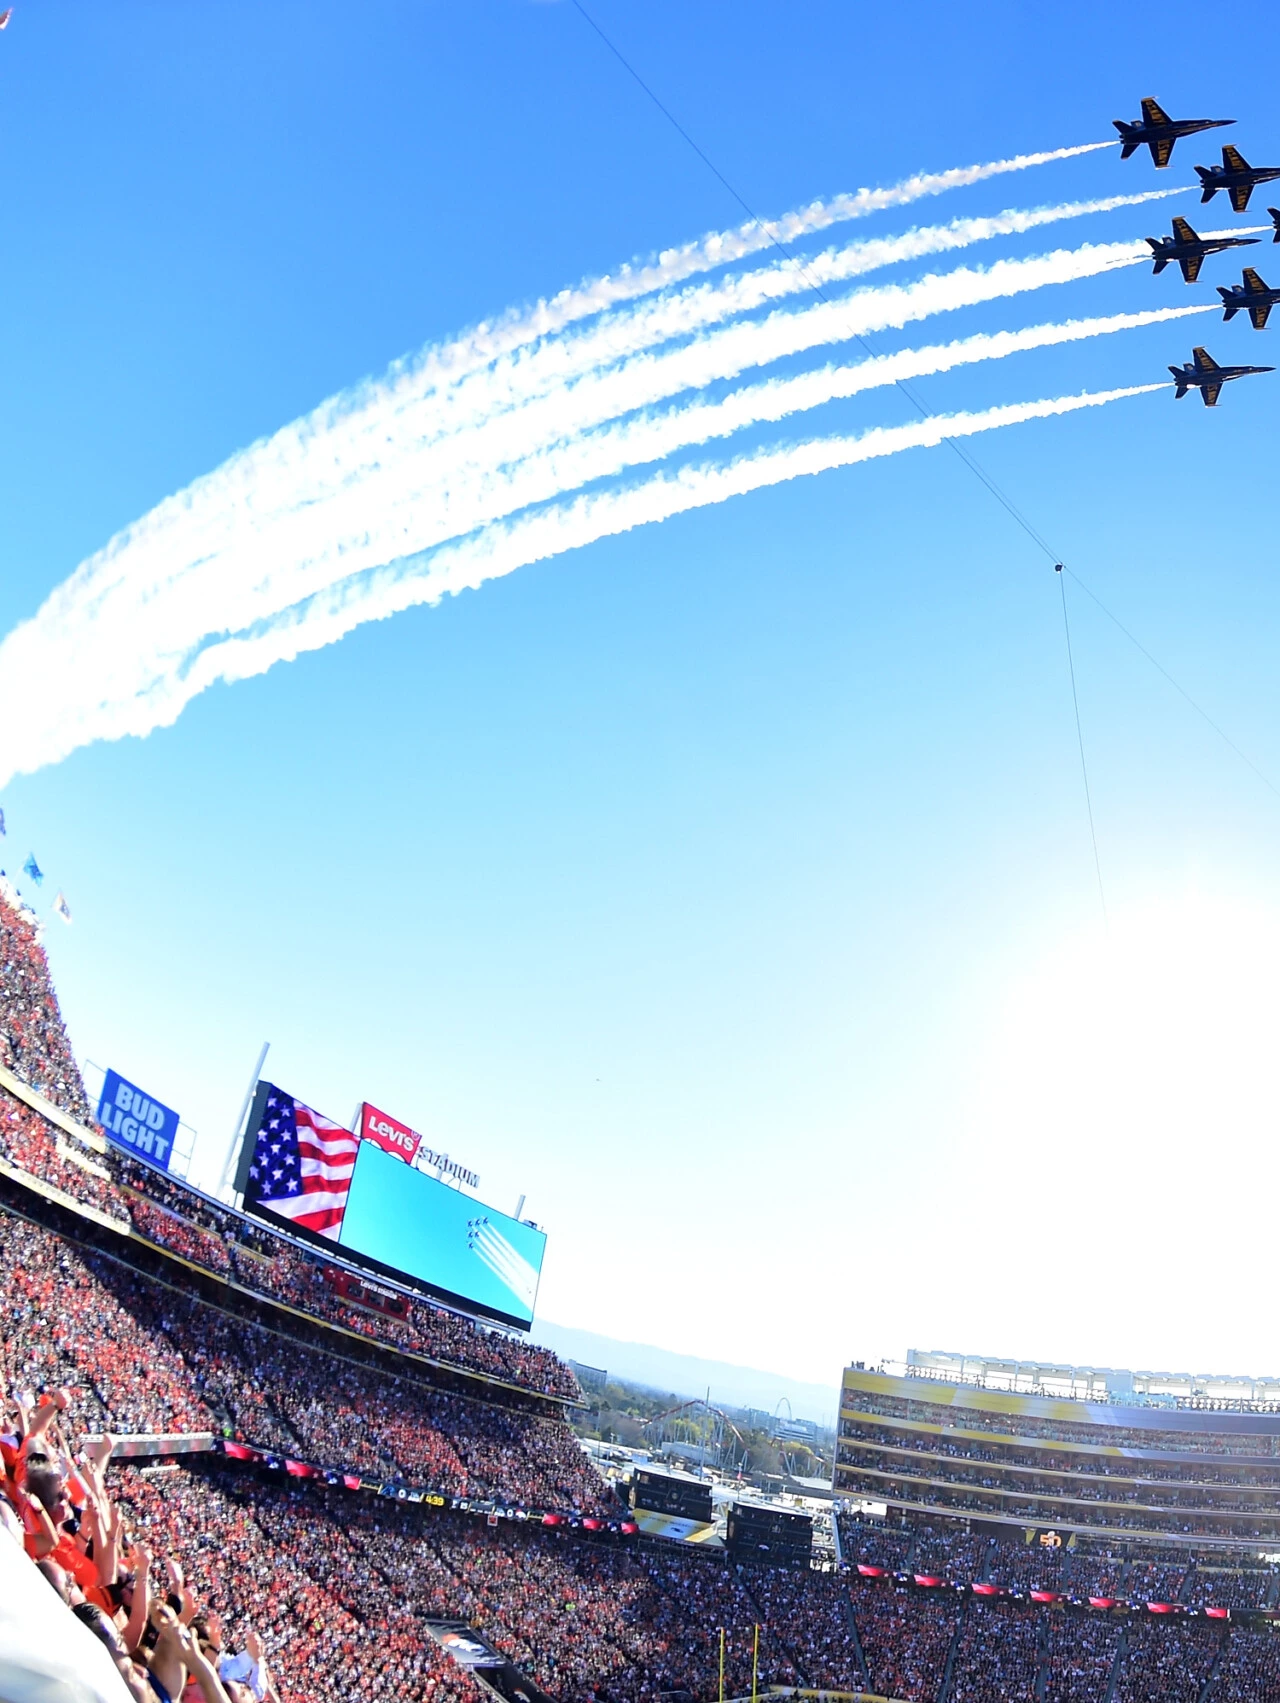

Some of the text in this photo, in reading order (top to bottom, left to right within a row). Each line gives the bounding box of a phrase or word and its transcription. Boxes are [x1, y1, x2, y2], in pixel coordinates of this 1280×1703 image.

[114, 1082, 165, 1131] BUD
[100, 1102, 170, 1162] LIGHT
[418, 1146, 480, 1189] STADIUM
